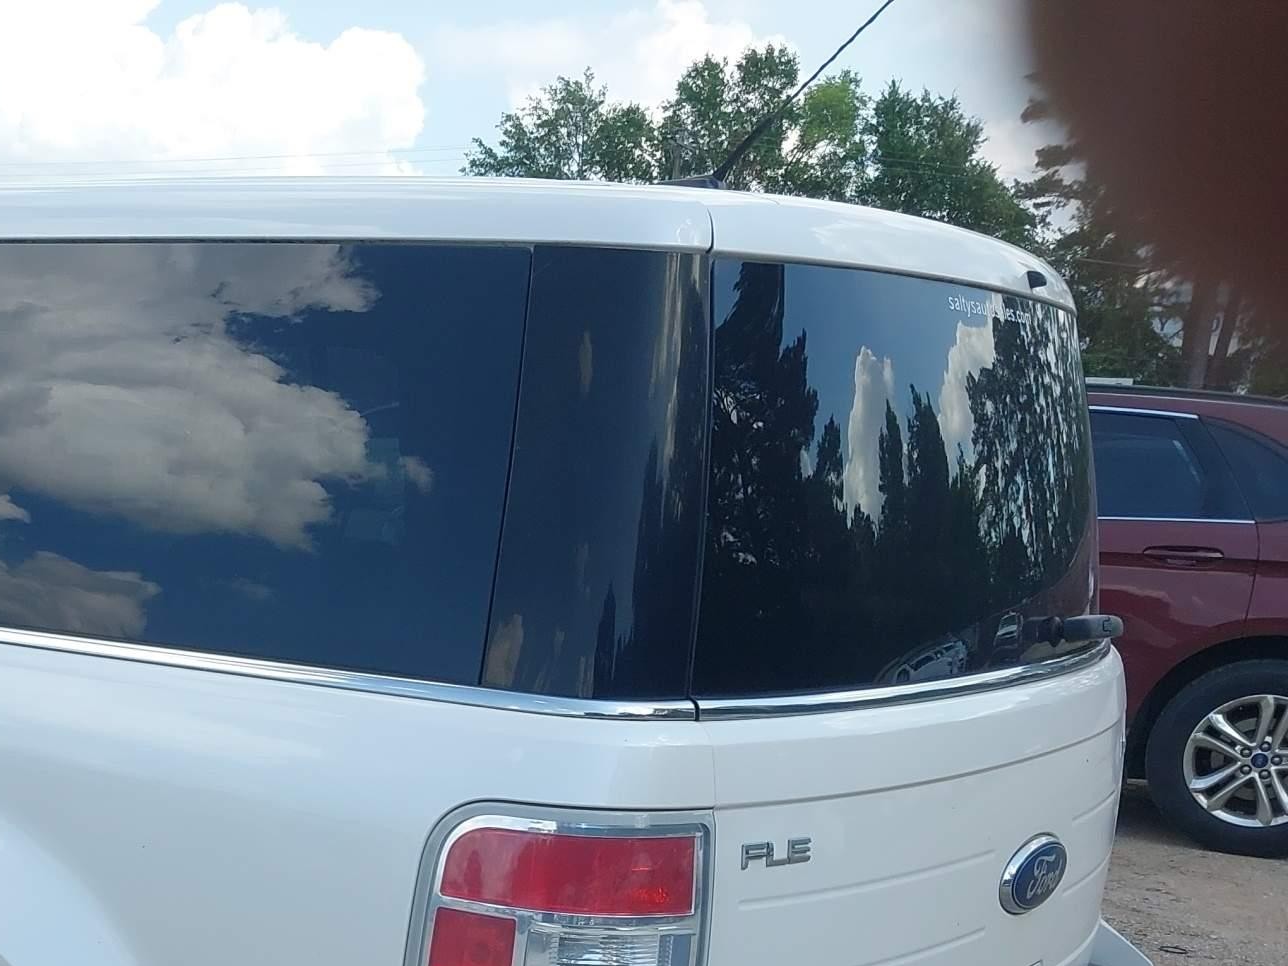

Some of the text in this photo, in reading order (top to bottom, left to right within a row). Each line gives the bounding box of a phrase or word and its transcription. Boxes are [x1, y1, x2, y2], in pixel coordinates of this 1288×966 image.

[948, 294, 1032, 325] saltysautosles.com
[741, 838, 813, 871] FLE
[1026, 854, 1064, 900] Ford
